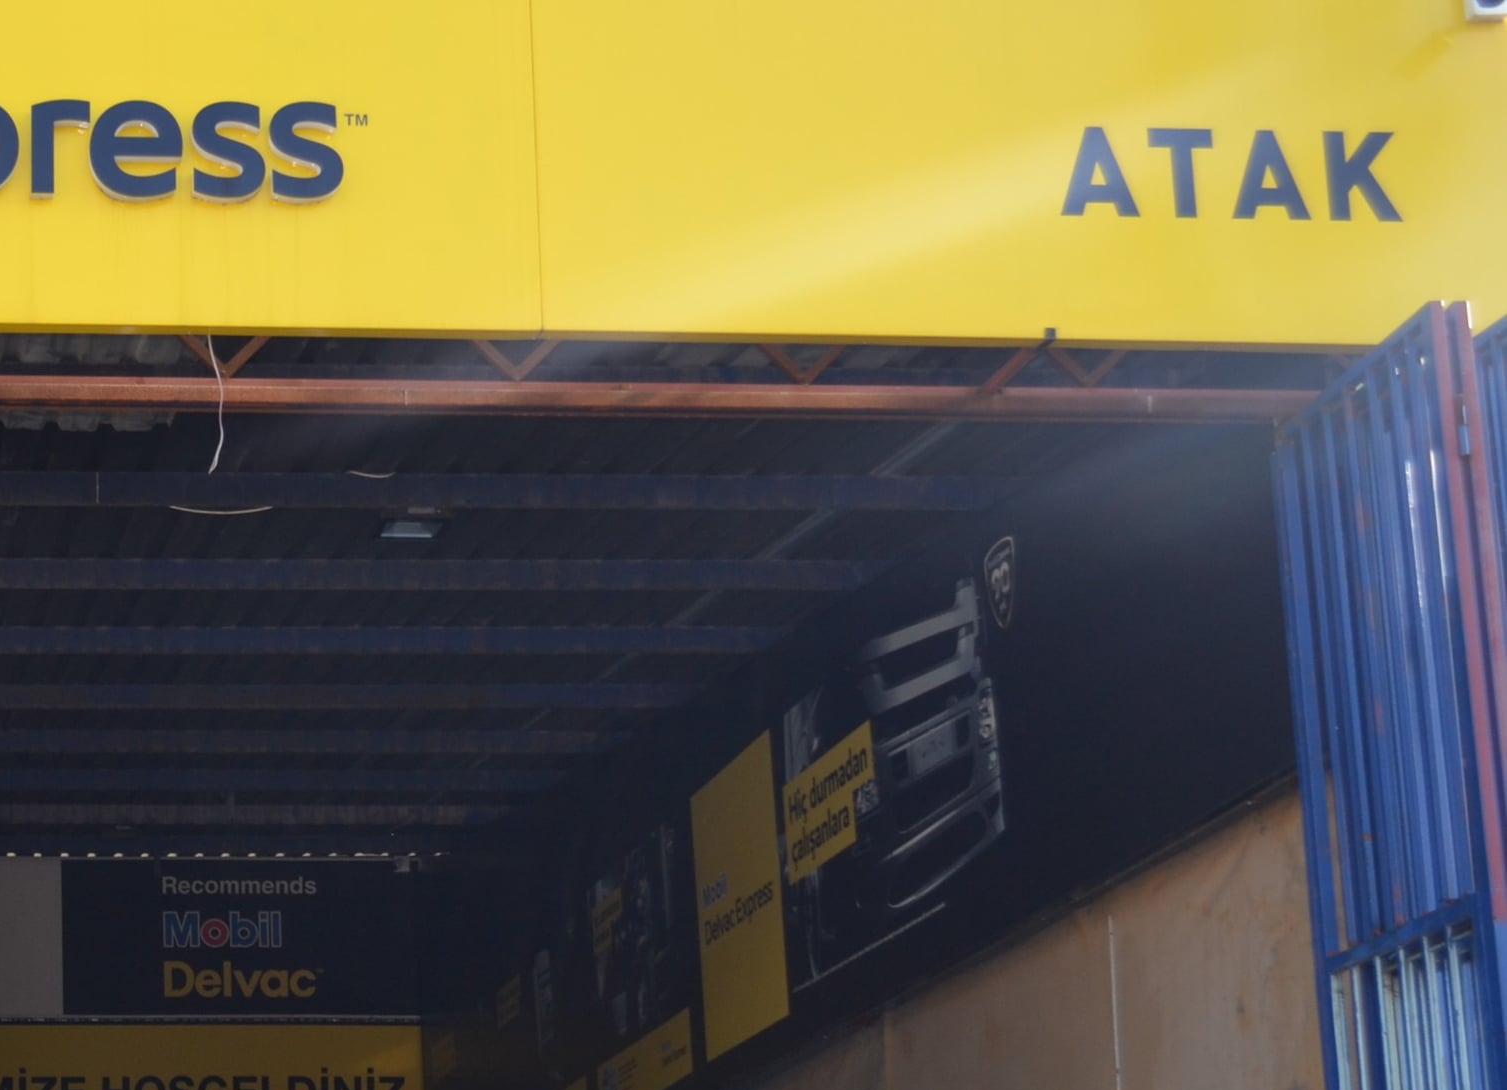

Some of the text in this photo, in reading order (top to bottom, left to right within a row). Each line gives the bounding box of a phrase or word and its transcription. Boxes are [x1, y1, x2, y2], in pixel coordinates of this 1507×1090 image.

[1061, 126, 1404, 222] ATAK
[788, 747, 869, 825] Hiç durmadan
[791, 804, 850, 870] çalışanlara
[161, 875, 317, 895] Recommends
[703, 881, 774, 945] Delvac Express
[162, 910, 283, 948] Mobil
[162, 960, 318, 999] Delvac
